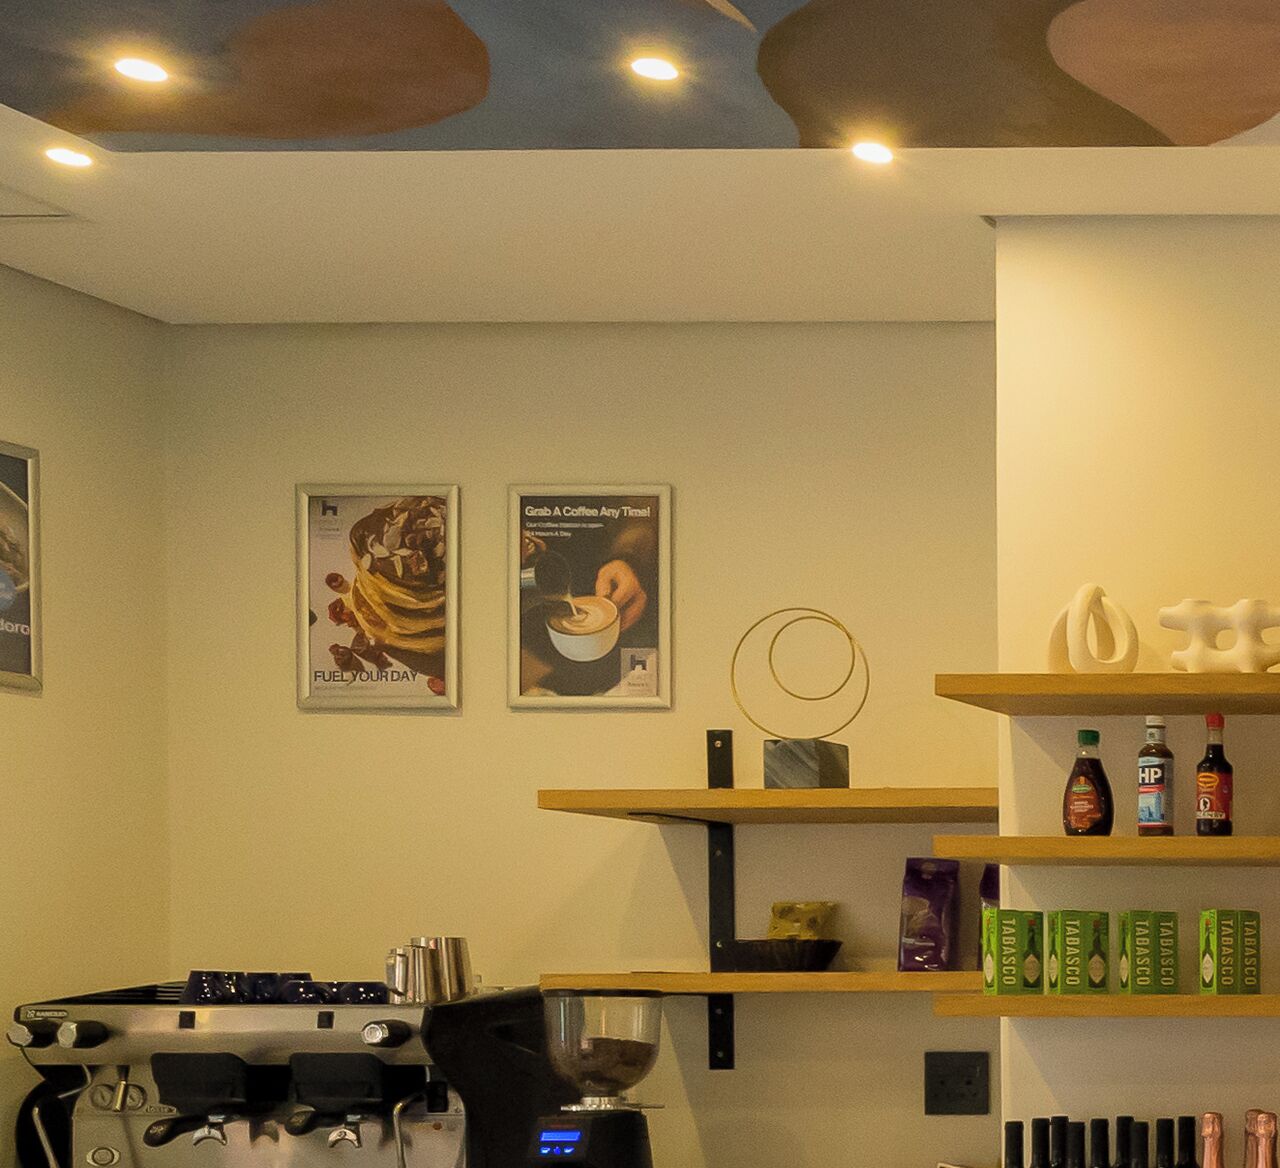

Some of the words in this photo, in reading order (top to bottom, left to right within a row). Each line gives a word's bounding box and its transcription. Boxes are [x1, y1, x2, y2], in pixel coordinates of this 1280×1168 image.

[525, 506, 551, 517] Grab
[553, 506, 561, 516] A
[563, 506, 598, 517] Coffee
[600, 506, 620, 519] Any
[622, 506, 650, 517] Time!
[314, 670, 346, 682] FUEL
[350, 670, 389, 685] YOUR
[391, 670, 418, 682] DAY
[1139, 767, 1162, 784] HP
[1002, 919, 1016, 985] TABASCO
[1066, 920, 1080, 985] TABASCO
[1135, 920, 1150, 985] TABASCO
[1160, 920, 1175, 986] TABASCO
[1221, 919, 1234, 986] TABASCO
[1244, 921, 1257, 986] TABASCO
